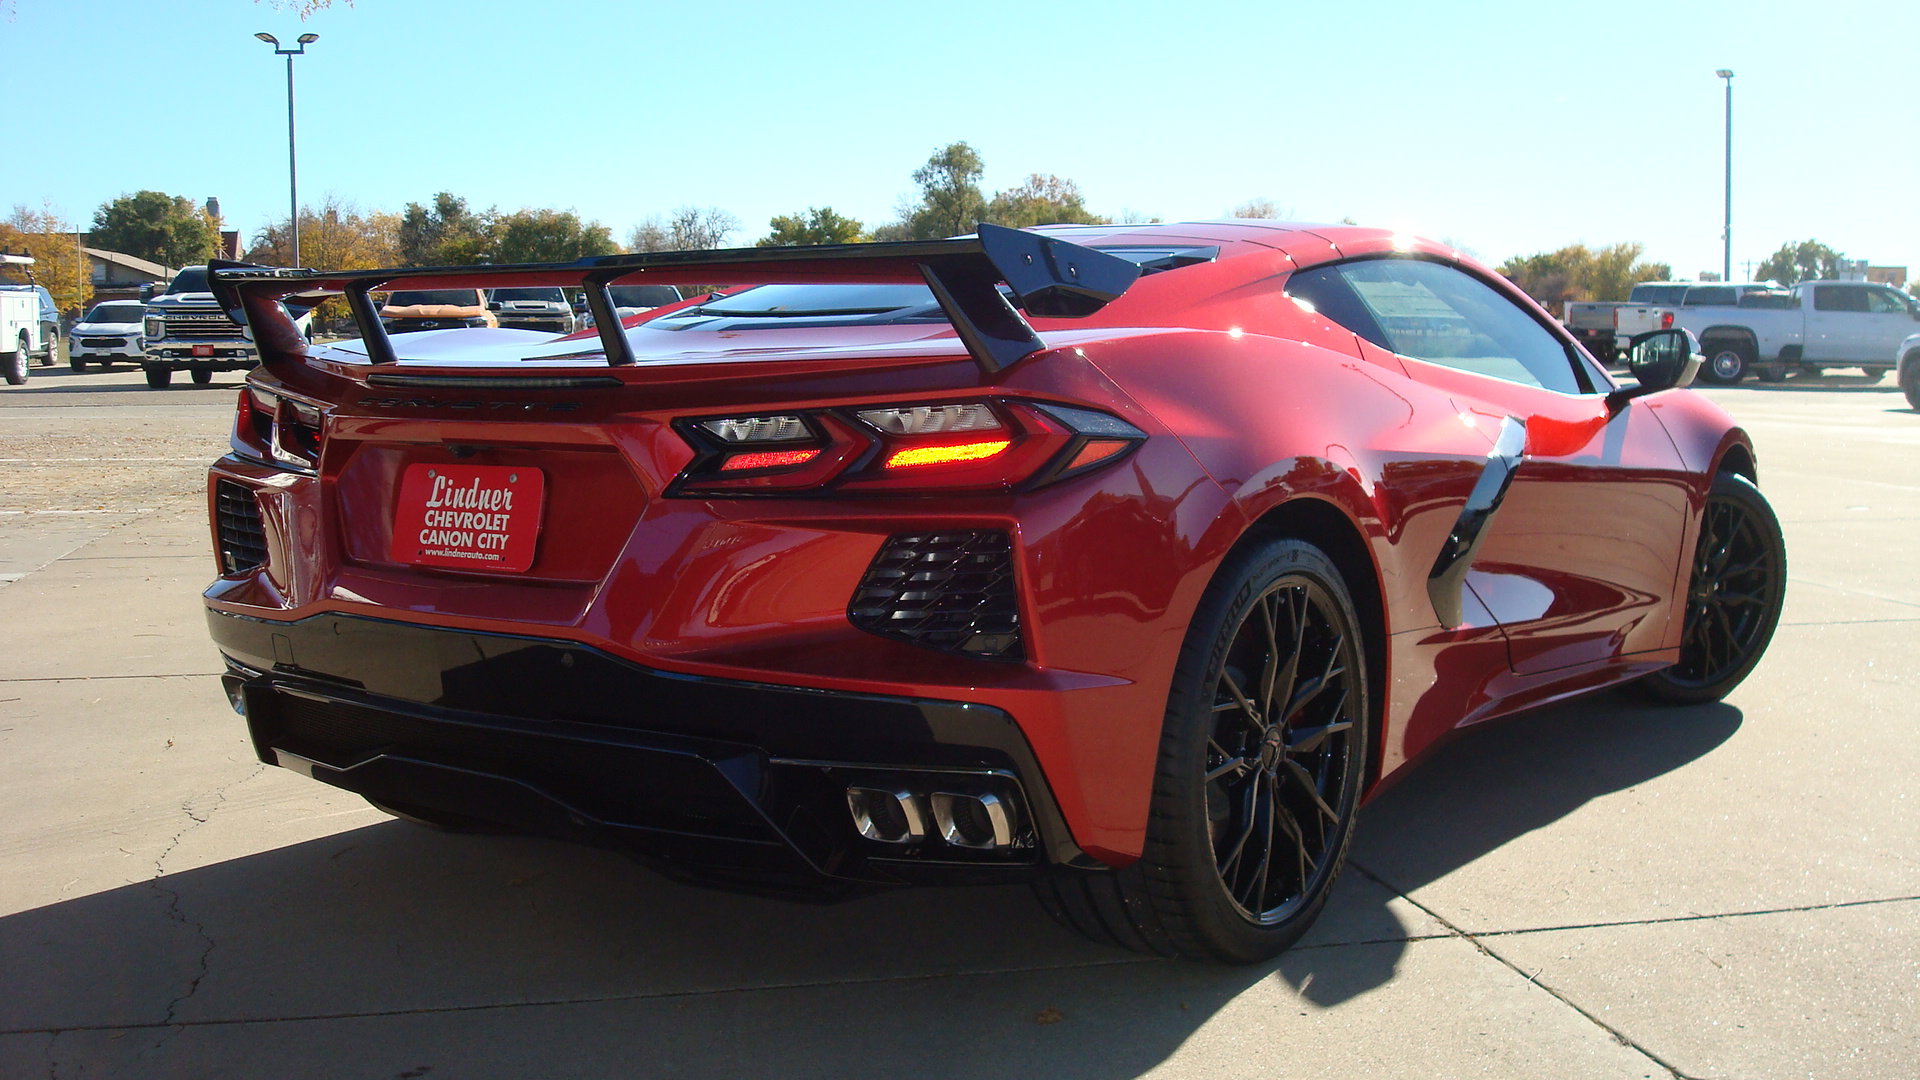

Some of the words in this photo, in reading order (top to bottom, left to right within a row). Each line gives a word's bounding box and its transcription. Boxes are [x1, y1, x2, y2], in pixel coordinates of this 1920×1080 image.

[426, 475, 513, 511] Lindner
[424, 510, 510, 531] CHEVROLET
[419, 529, 473, 547] CANON
[477, 533, 509, 550] CITY
[425, 548, 499, 561] www.lindnerauto.com
